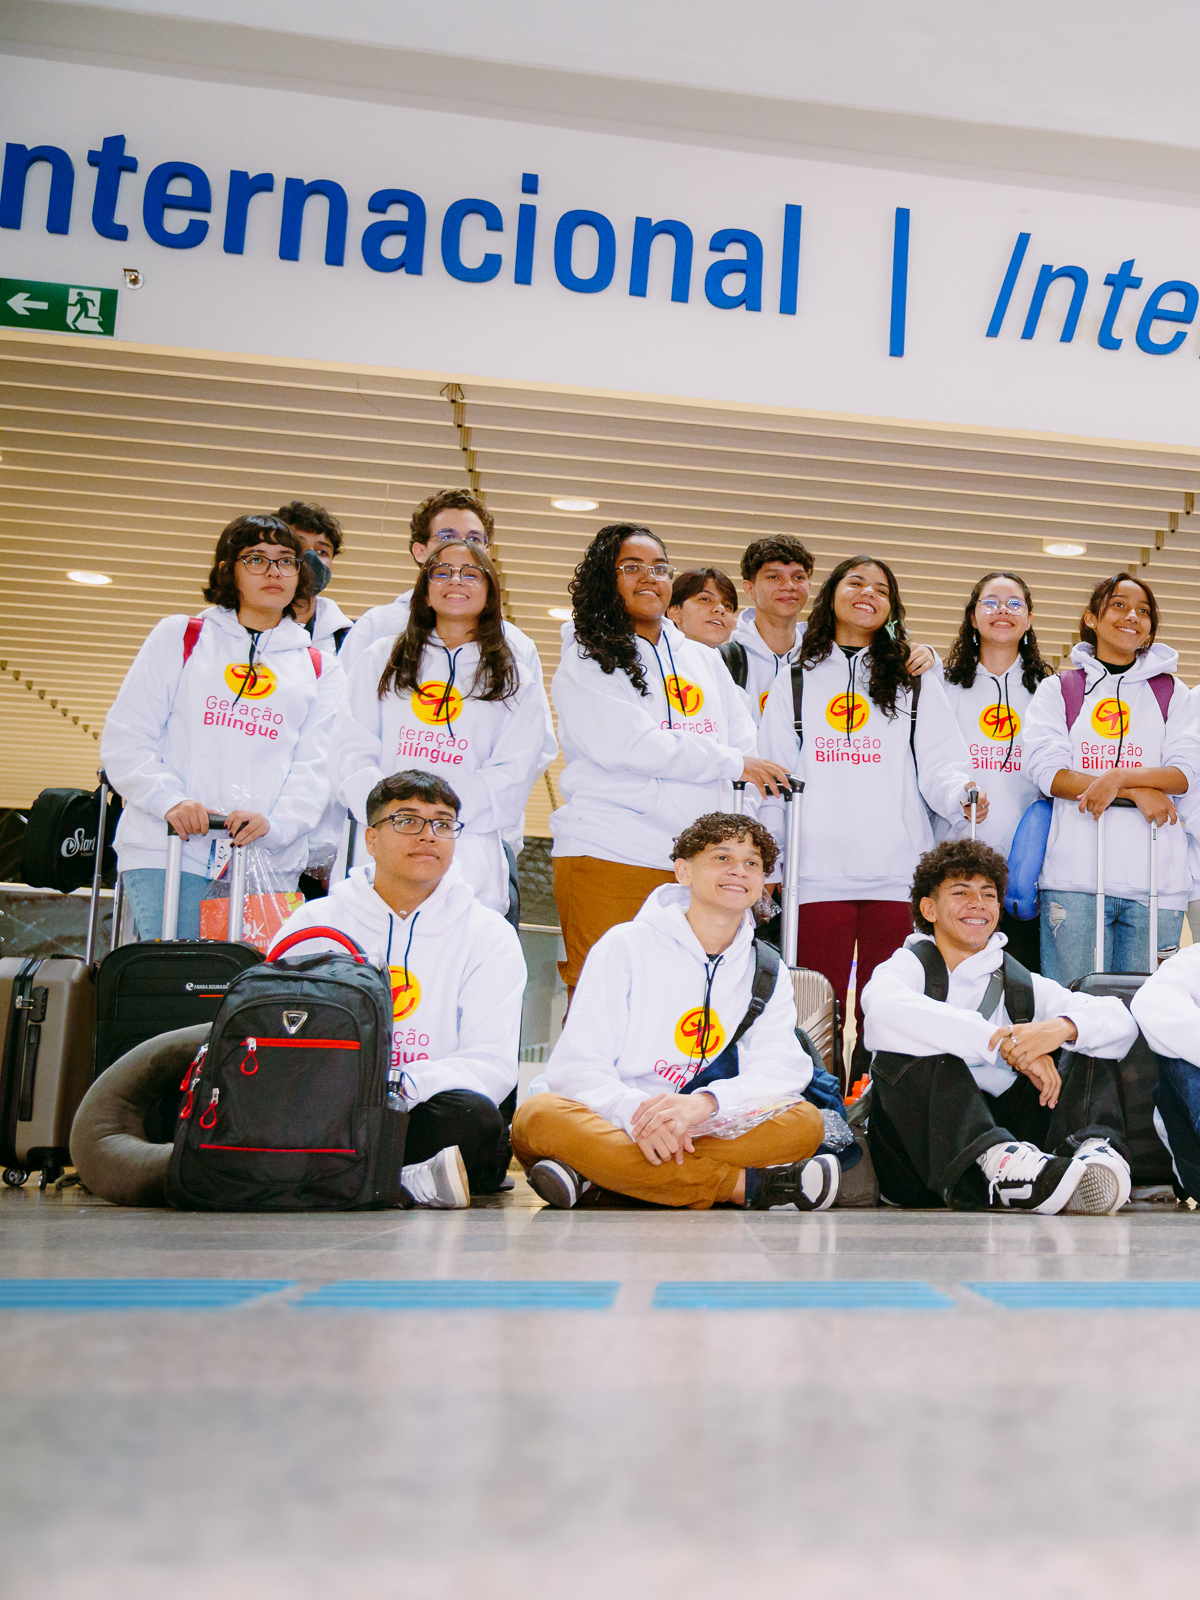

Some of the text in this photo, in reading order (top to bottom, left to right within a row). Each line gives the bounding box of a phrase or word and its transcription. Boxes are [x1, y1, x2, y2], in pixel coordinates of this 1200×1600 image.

[0, 134, 803, 316] nternacional
[206, 695, 284, 725] Geração
[203, 711, 279, 740] Bilíngue
[399, 725, 469, 751] Geração
[815, 736, 881, 752] Geração
[815, 748, 882, 765] Bilíngue
[969, 743, 1022, 760] Geraçã
[1081, 741, 1143, 759] Geração
[972, 756, 1022, 773] Bilíngu
